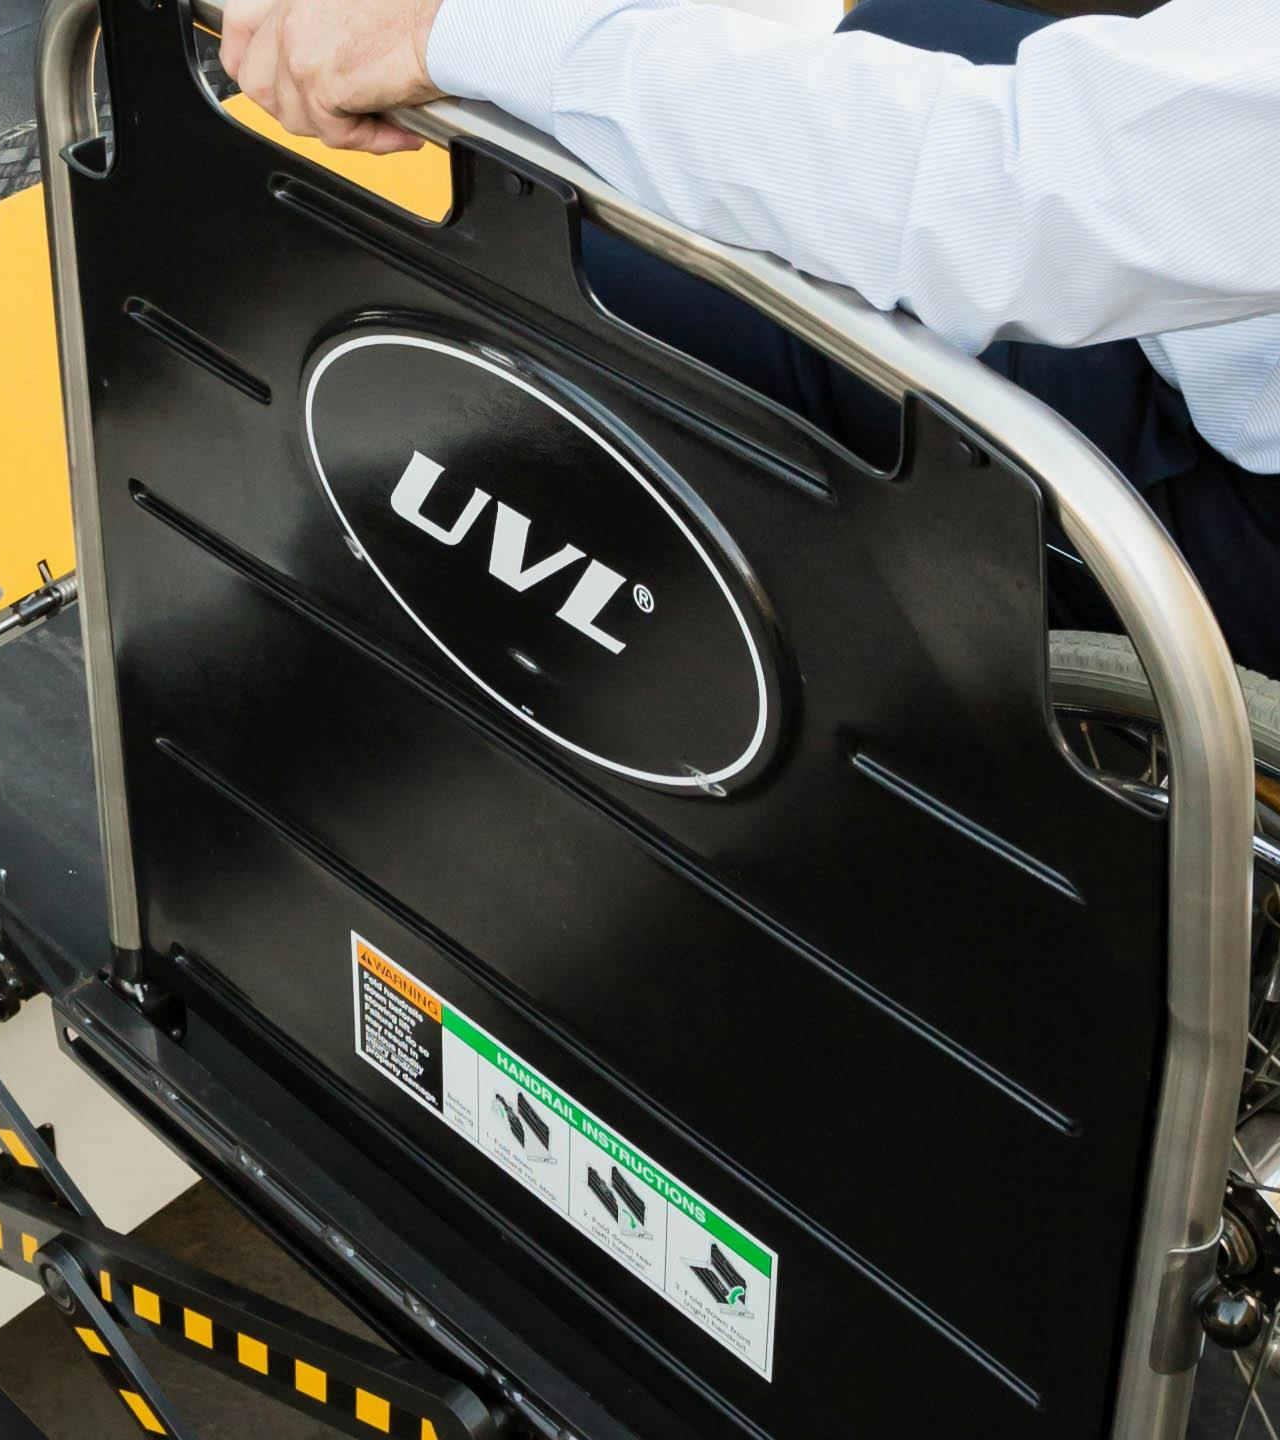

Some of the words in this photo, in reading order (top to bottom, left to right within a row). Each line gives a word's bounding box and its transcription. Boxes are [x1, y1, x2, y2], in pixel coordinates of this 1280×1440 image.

[363, 969, 382, 991] Fold
[373, 957, 438, 1016] WARNING
[363, 981, 386, 1006] down
[388, 1000, 414, 1028] before
[364, 1001, 393, 1031] Failure
[394, 1025, 403, 1038] to
[405, 1033, 416, 1048] do
[418, 1043, 429, 1059] so
[365, 1013, 382, 1035] may
[383, 1026, 408, 1052] result
[409, 1046, 418, 1060] in
[365, 1023, 395, 1052] serious
[365, 1043, 400, 1078] property
[496, 1051, 578, 1127] HANDRAIL
[581, 1118, 706, 1224] INSTRUCTIONS
